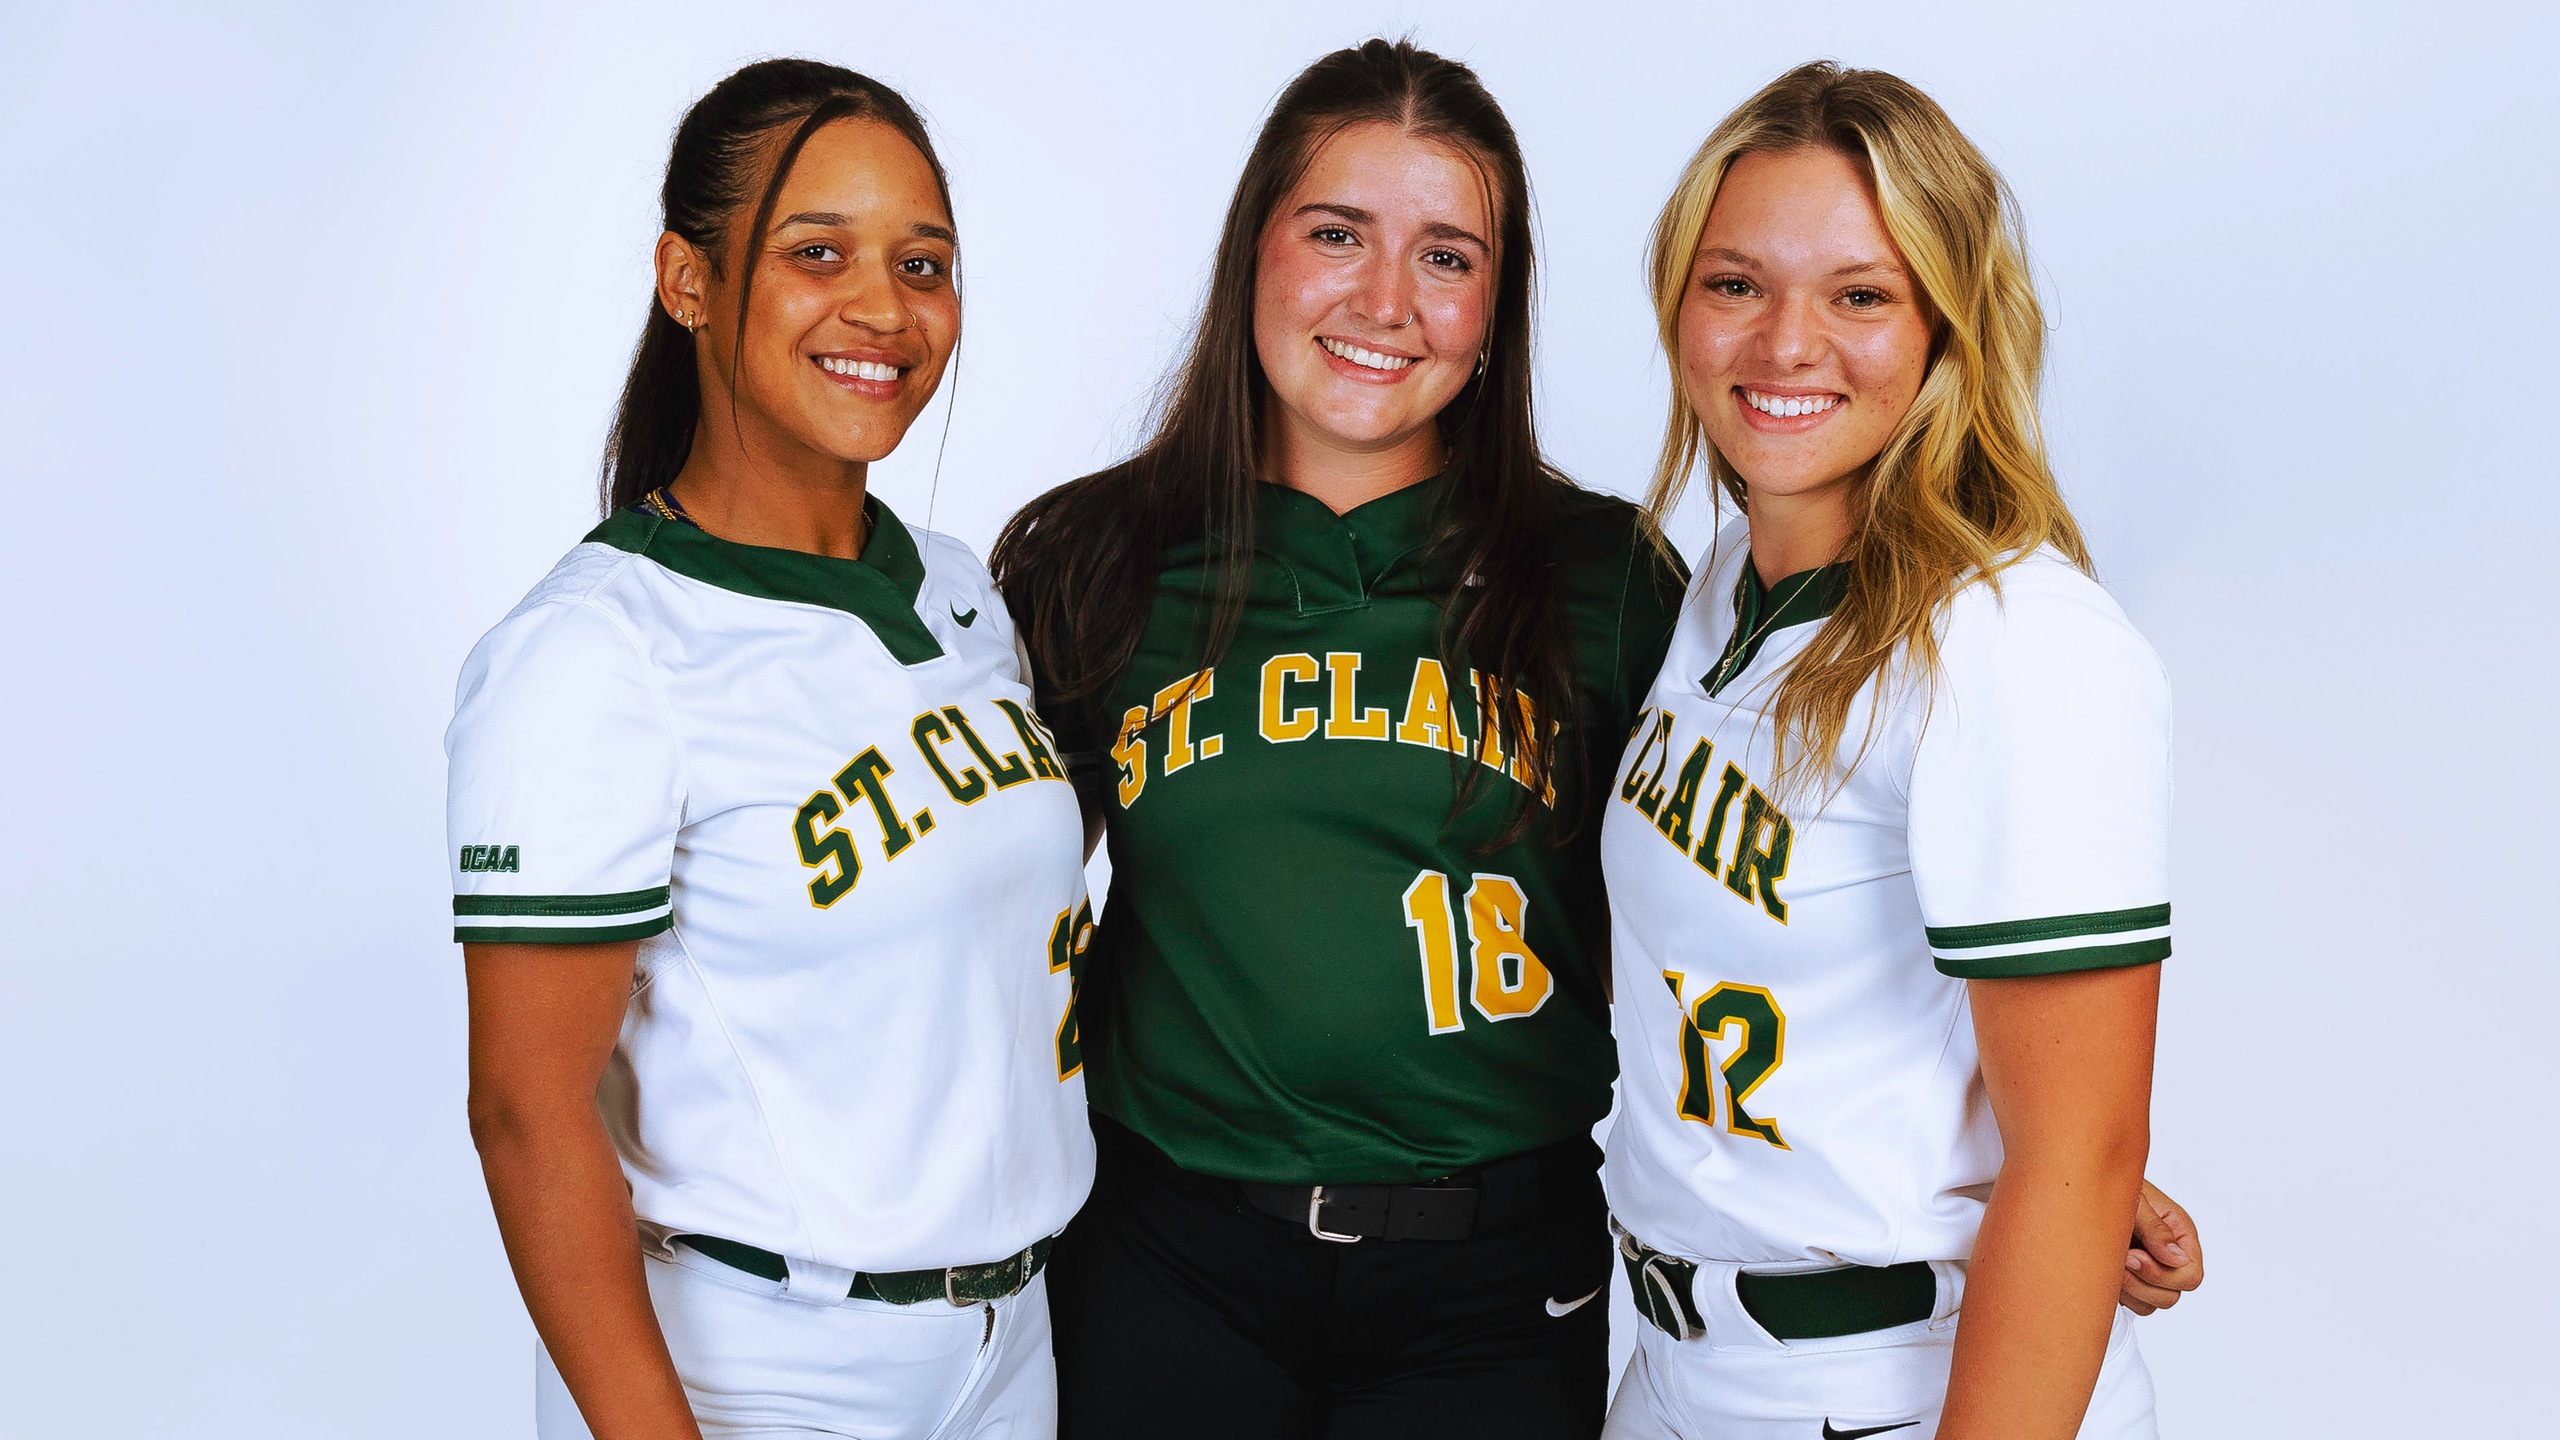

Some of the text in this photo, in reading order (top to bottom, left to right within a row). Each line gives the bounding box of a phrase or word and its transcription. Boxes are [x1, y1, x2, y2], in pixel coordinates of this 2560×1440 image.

[792, 698, 1070, 909] ST. CLA
[1110, 666, 1224, 810] ST.
[1620, 706, 1795, 927] CLAIR
[460, 845, 520, 873] OCAA
[1402, 869, 1554, 1036] 18
[1662, 969, 1793, 1152] 12
